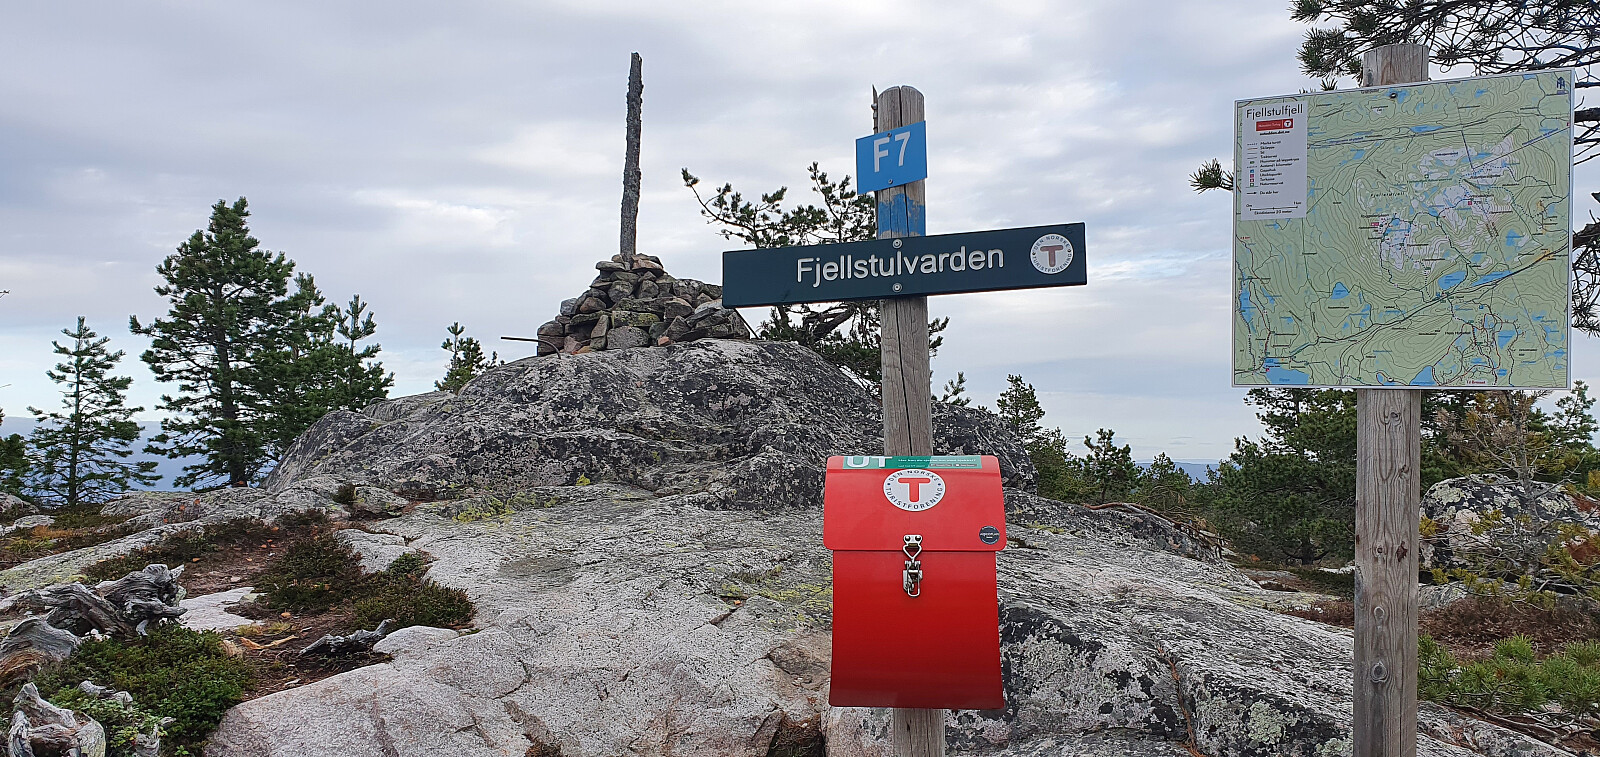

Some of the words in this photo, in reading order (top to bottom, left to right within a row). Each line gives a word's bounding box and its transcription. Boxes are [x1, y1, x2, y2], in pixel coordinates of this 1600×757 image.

[1246, 104, 1303, 120] Fjellstulfjell
[873, 131, 911, 173] F7
[1034, 240, 1044, 251] DEN
[1046, 235, 1071, 248] NORSKE
[796, 246, 1004, 288] Fjellstulvarden
[1032, 253, 1072, 272] TURISTFORENING
[1040, 245, 1064, 267] T
[888, 472, 903, 482] DEN
[907, 470, 940, 482] NORSKE
[886, 487, 943, 510] TURISTFORENING
[898, 478, 930, 502] T
